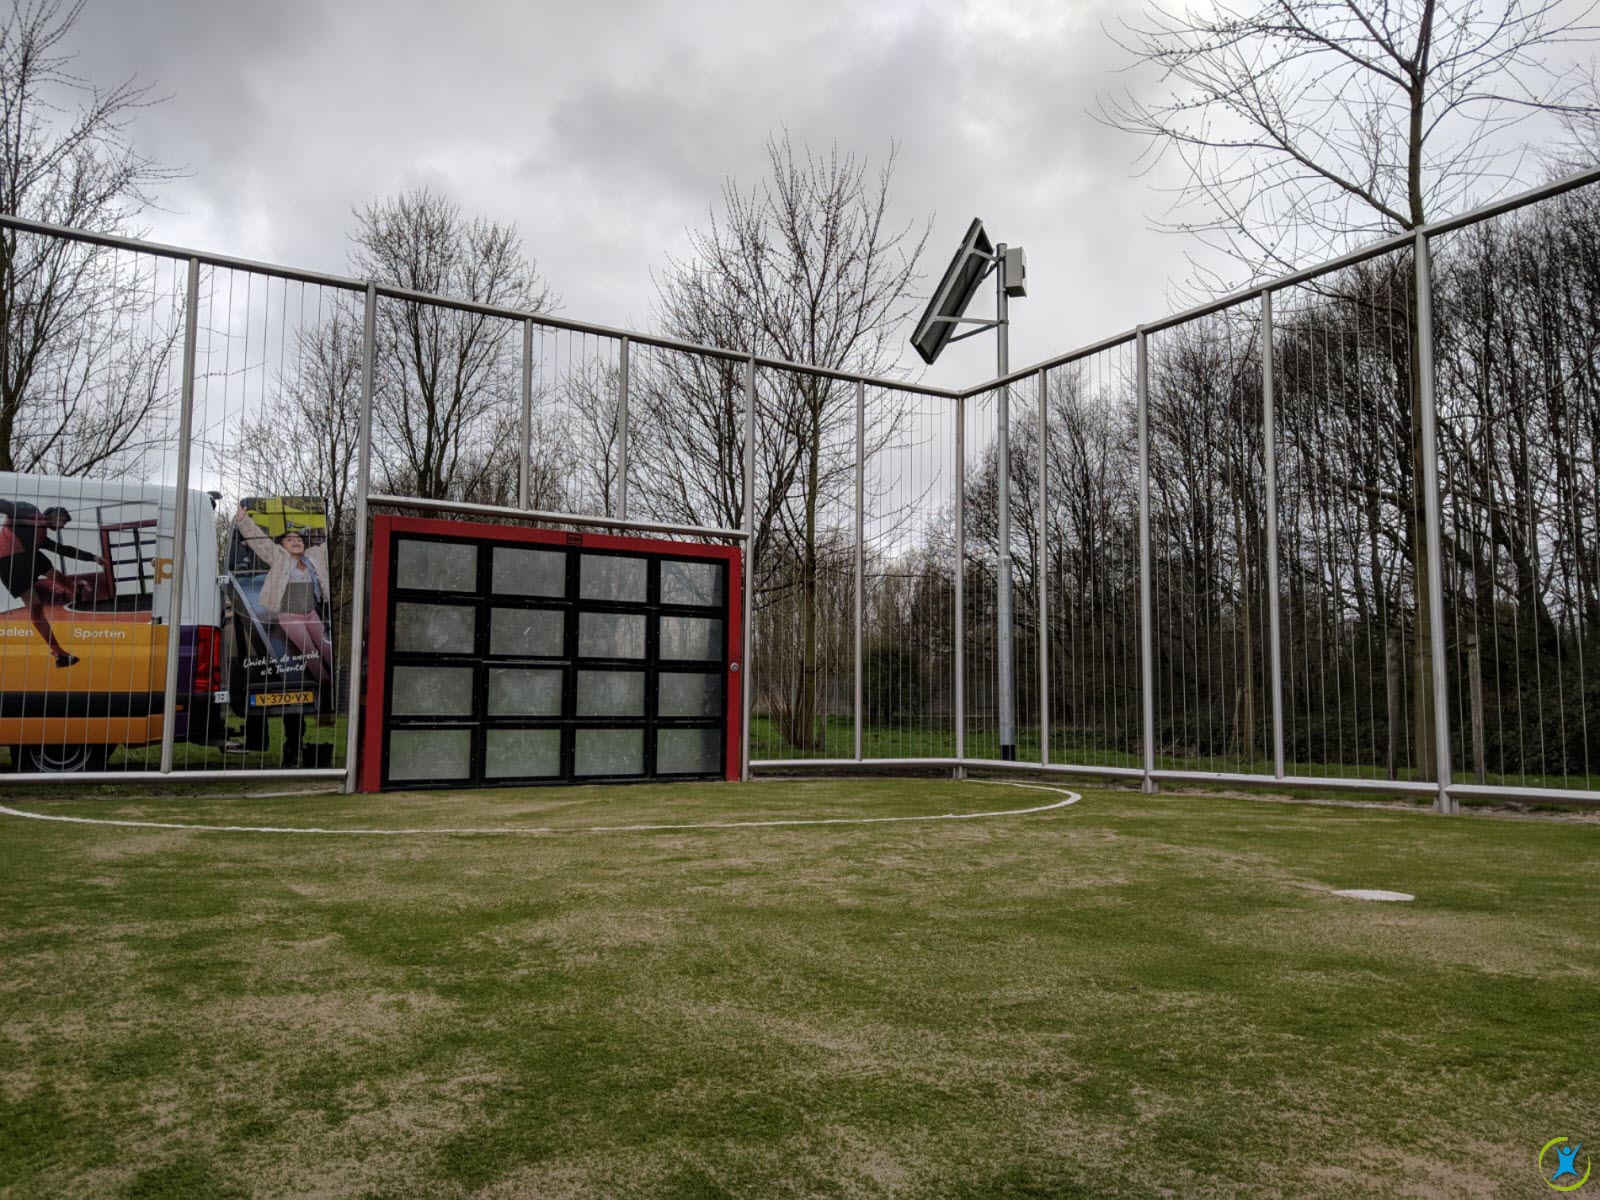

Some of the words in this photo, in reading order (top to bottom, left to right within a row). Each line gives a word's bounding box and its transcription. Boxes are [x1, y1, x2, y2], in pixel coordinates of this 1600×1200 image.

[73, 628, 126, 640] Sporten
[243, 656, 267, 668] Uniek
[259, 693, 309, 704] V-370-VX
